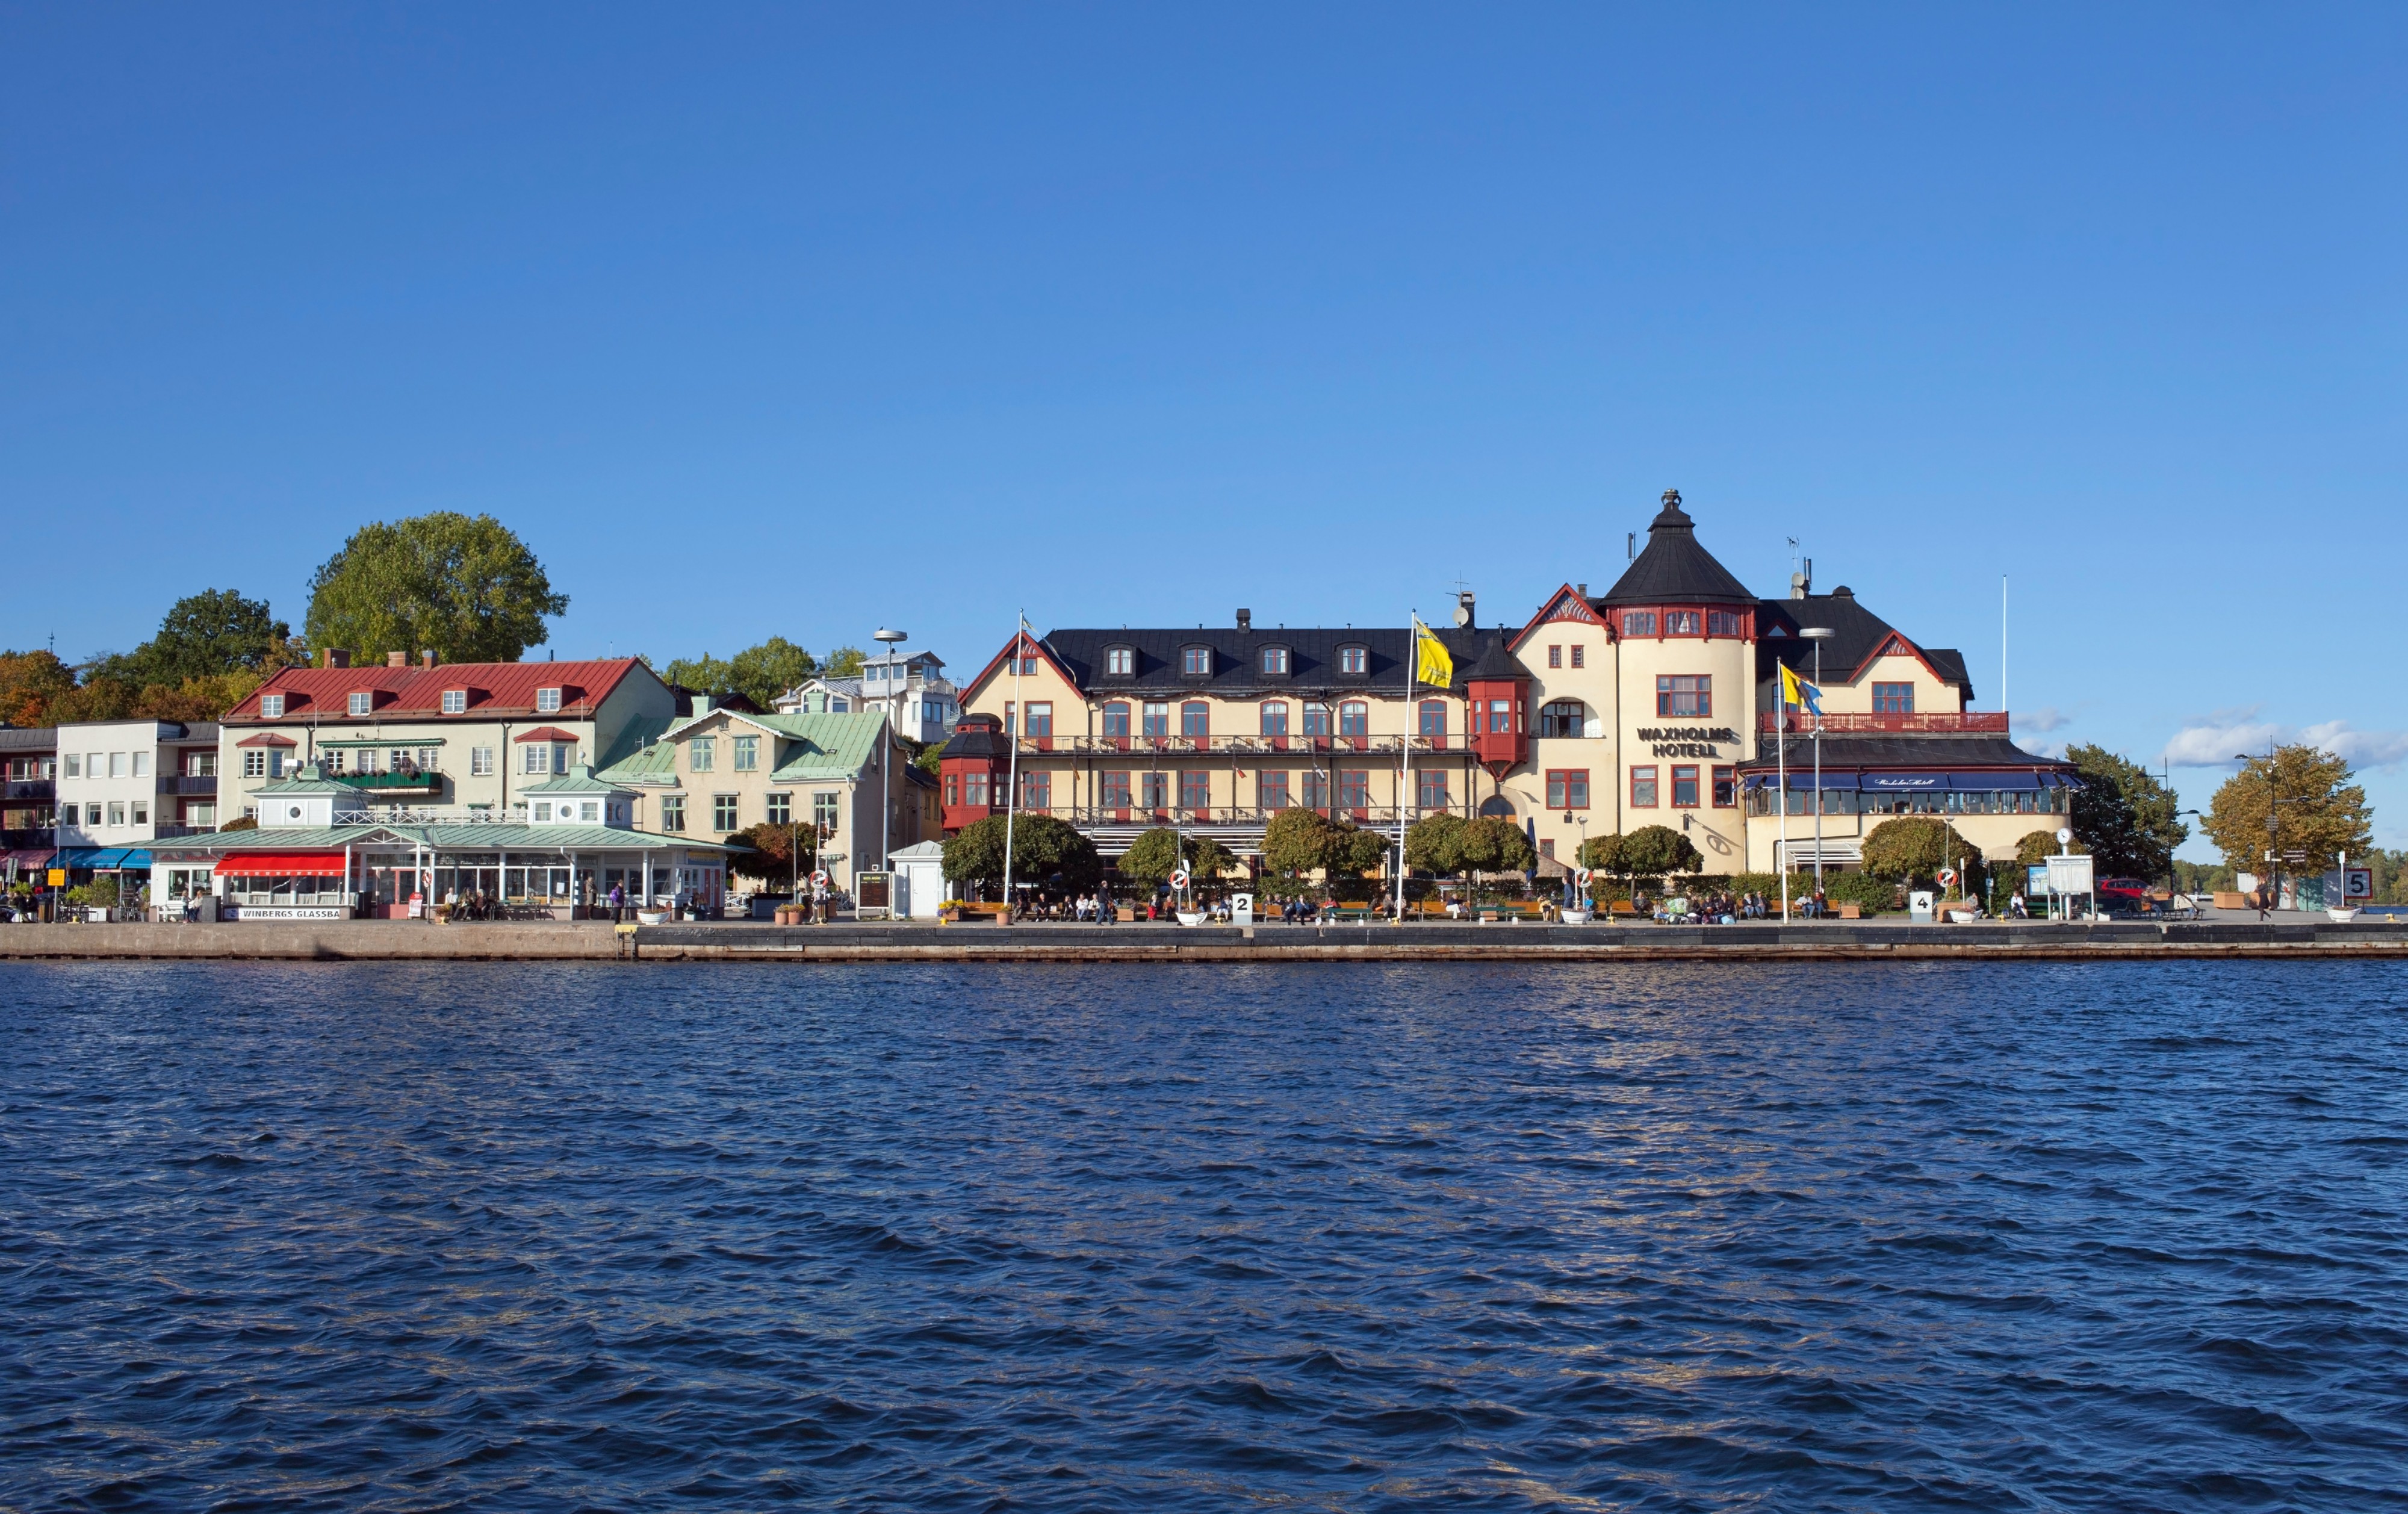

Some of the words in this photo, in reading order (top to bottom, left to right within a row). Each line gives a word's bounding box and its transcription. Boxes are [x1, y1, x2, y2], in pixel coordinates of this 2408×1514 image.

[1637, 727, 1732, 740] WAXHOLMS
[1652, 743, 1717, 756] HOTELL
[2350, 874, 2364, 893] 5
[1237, 898, 1247, 911] 2
[1917, 897, 1928, 908] 4
